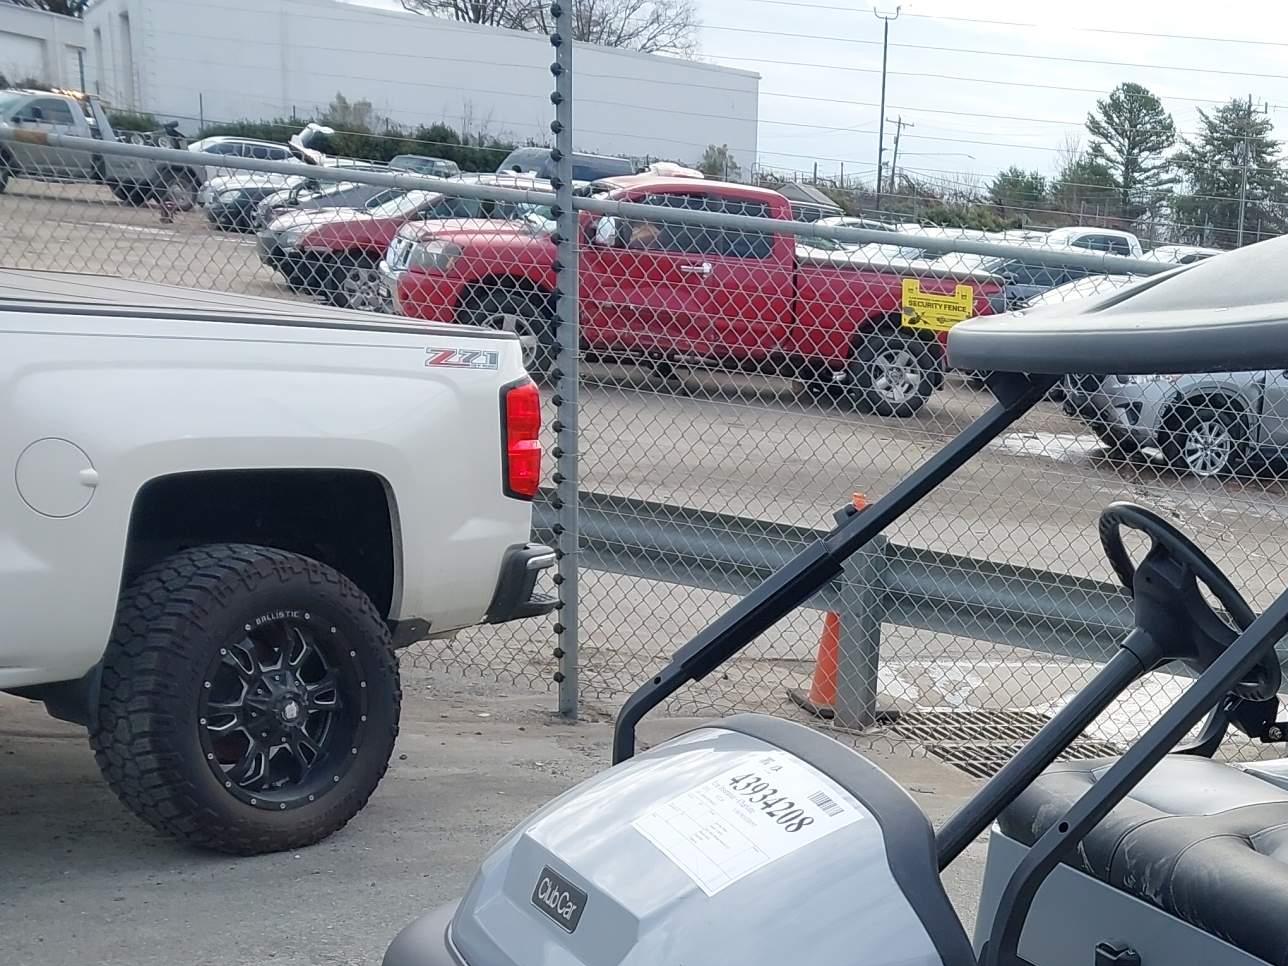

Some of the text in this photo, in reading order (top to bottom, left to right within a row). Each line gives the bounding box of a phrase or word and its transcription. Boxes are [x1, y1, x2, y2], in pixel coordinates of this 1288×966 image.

[908, 300, 943, 310] SECURITY
[943, 303, 967, 312] FENCE
[425, 347, 499, 370] Z71
[255, 610, 299, 625] BALLISTIC
[729, 772, 815, 833] 43934208
